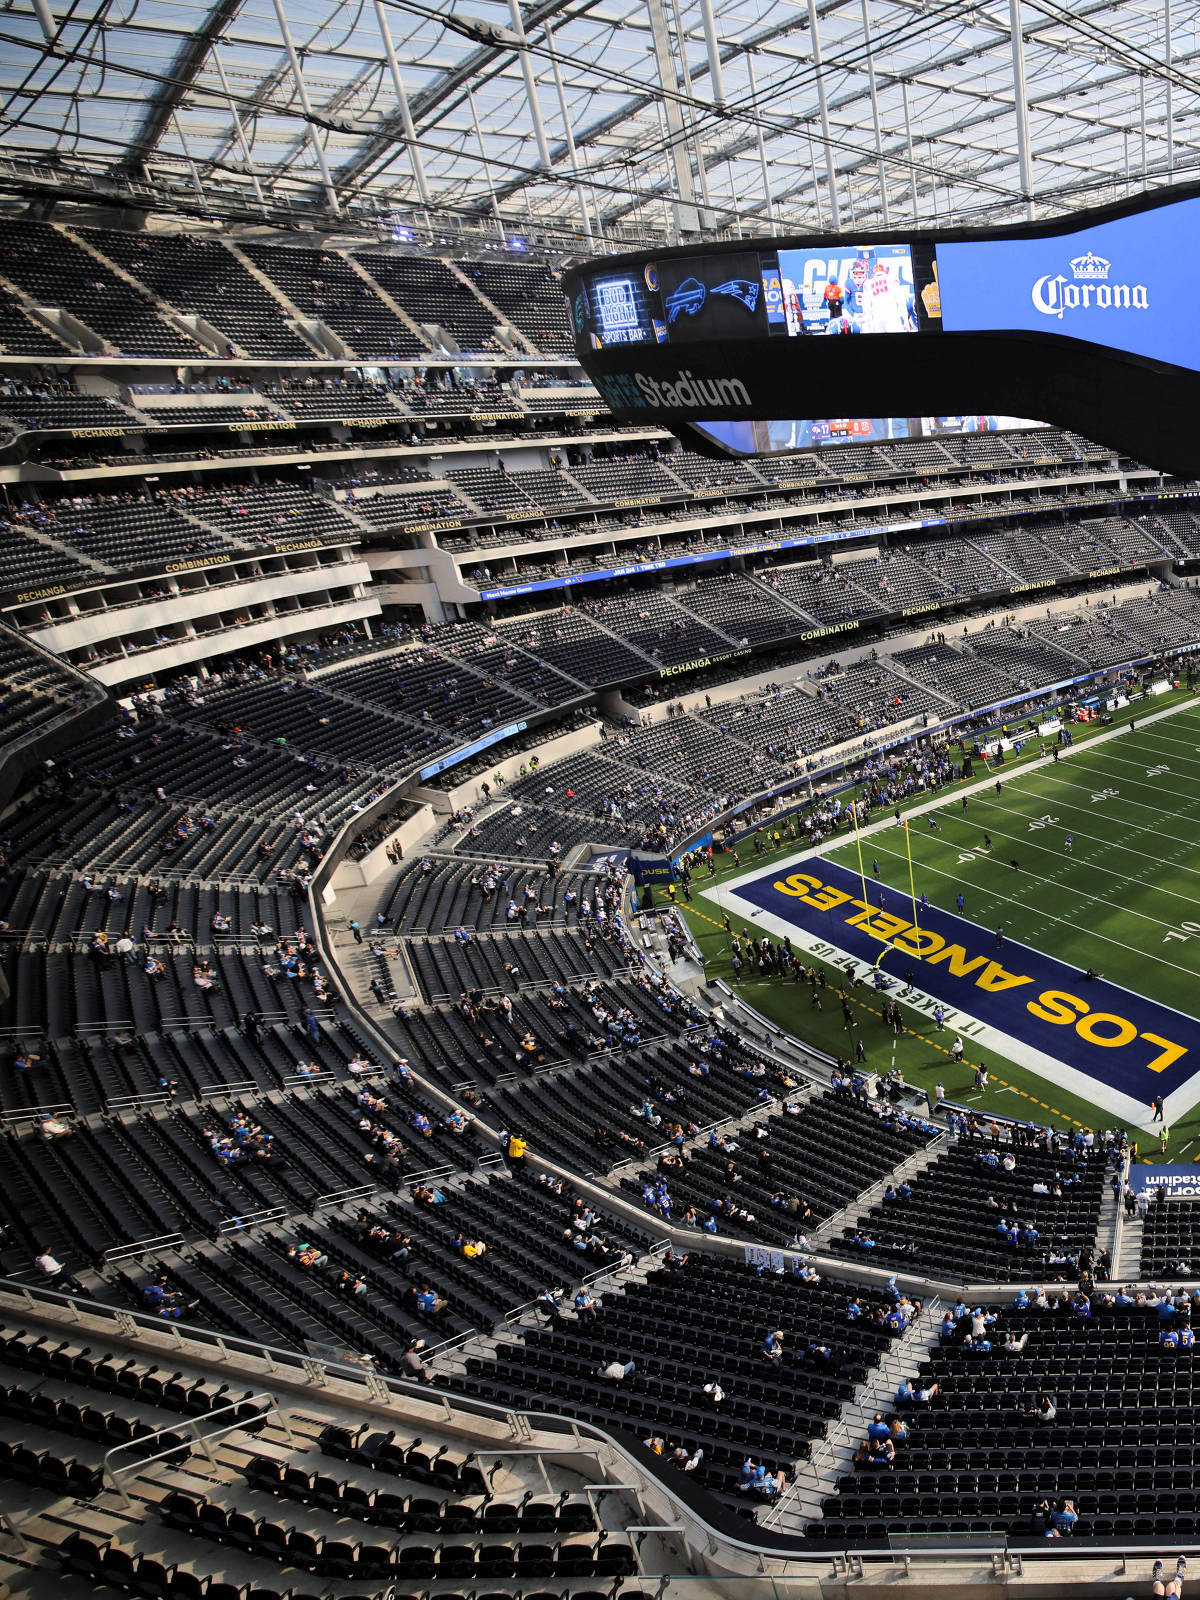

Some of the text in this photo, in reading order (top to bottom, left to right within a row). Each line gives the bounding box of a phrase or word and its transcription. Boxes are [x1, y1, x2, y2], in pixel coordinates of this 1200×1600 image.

[602, 286, 626, 305] BUD
[1032, 274, 1150, 319] Corona
[601, 304, 636, 322] LIGHT
[603, 330, 628, 343] SPORTS
[628, 329, 643, 340] BAR
[634, 370, 752, 408] Stadium
[470, 412, 524, 421] COMBINATION
[565, 409, 600, 417] PECHANGA
[228, 422, 296, 432] COMBINATION
[342, 418, 388, 427] PECHANGA
[71, 428, 124, 439] PECHANGA
[779, 480, 816, 489] COMBINATION
[615, 497, 661, 507] COMBINATION
[506, 510, 545, 521] PECHANGA
[404, 520, 462, 534] COMBINATION
[275, 540, 323, 553] PECHANGA
[165, 555, 231, 573] COMBINATION
[1089, 567, 1120, 579] PECHANGA
[17, 585, 66, 603] PECHANGA
[1009, 579, 1056, 594] COMBINATION
[902, 602, 940, 617] PECHANGA
[800, 620, 859, 641] COMBINATION
[660, 648, 752, 679] PECHANGA RESORT CASINO
[1092, 788, 1120, 803] 30
[1029, 814, 1060, 832] 20
[957, 845, 992, 865] 10
[809, 942, 836, 958] US
[832, 957, 860, 969] OF
[773, 873, 1189, 1073] LOS ANGELES
[958, 1021, 986, 1037] IT
